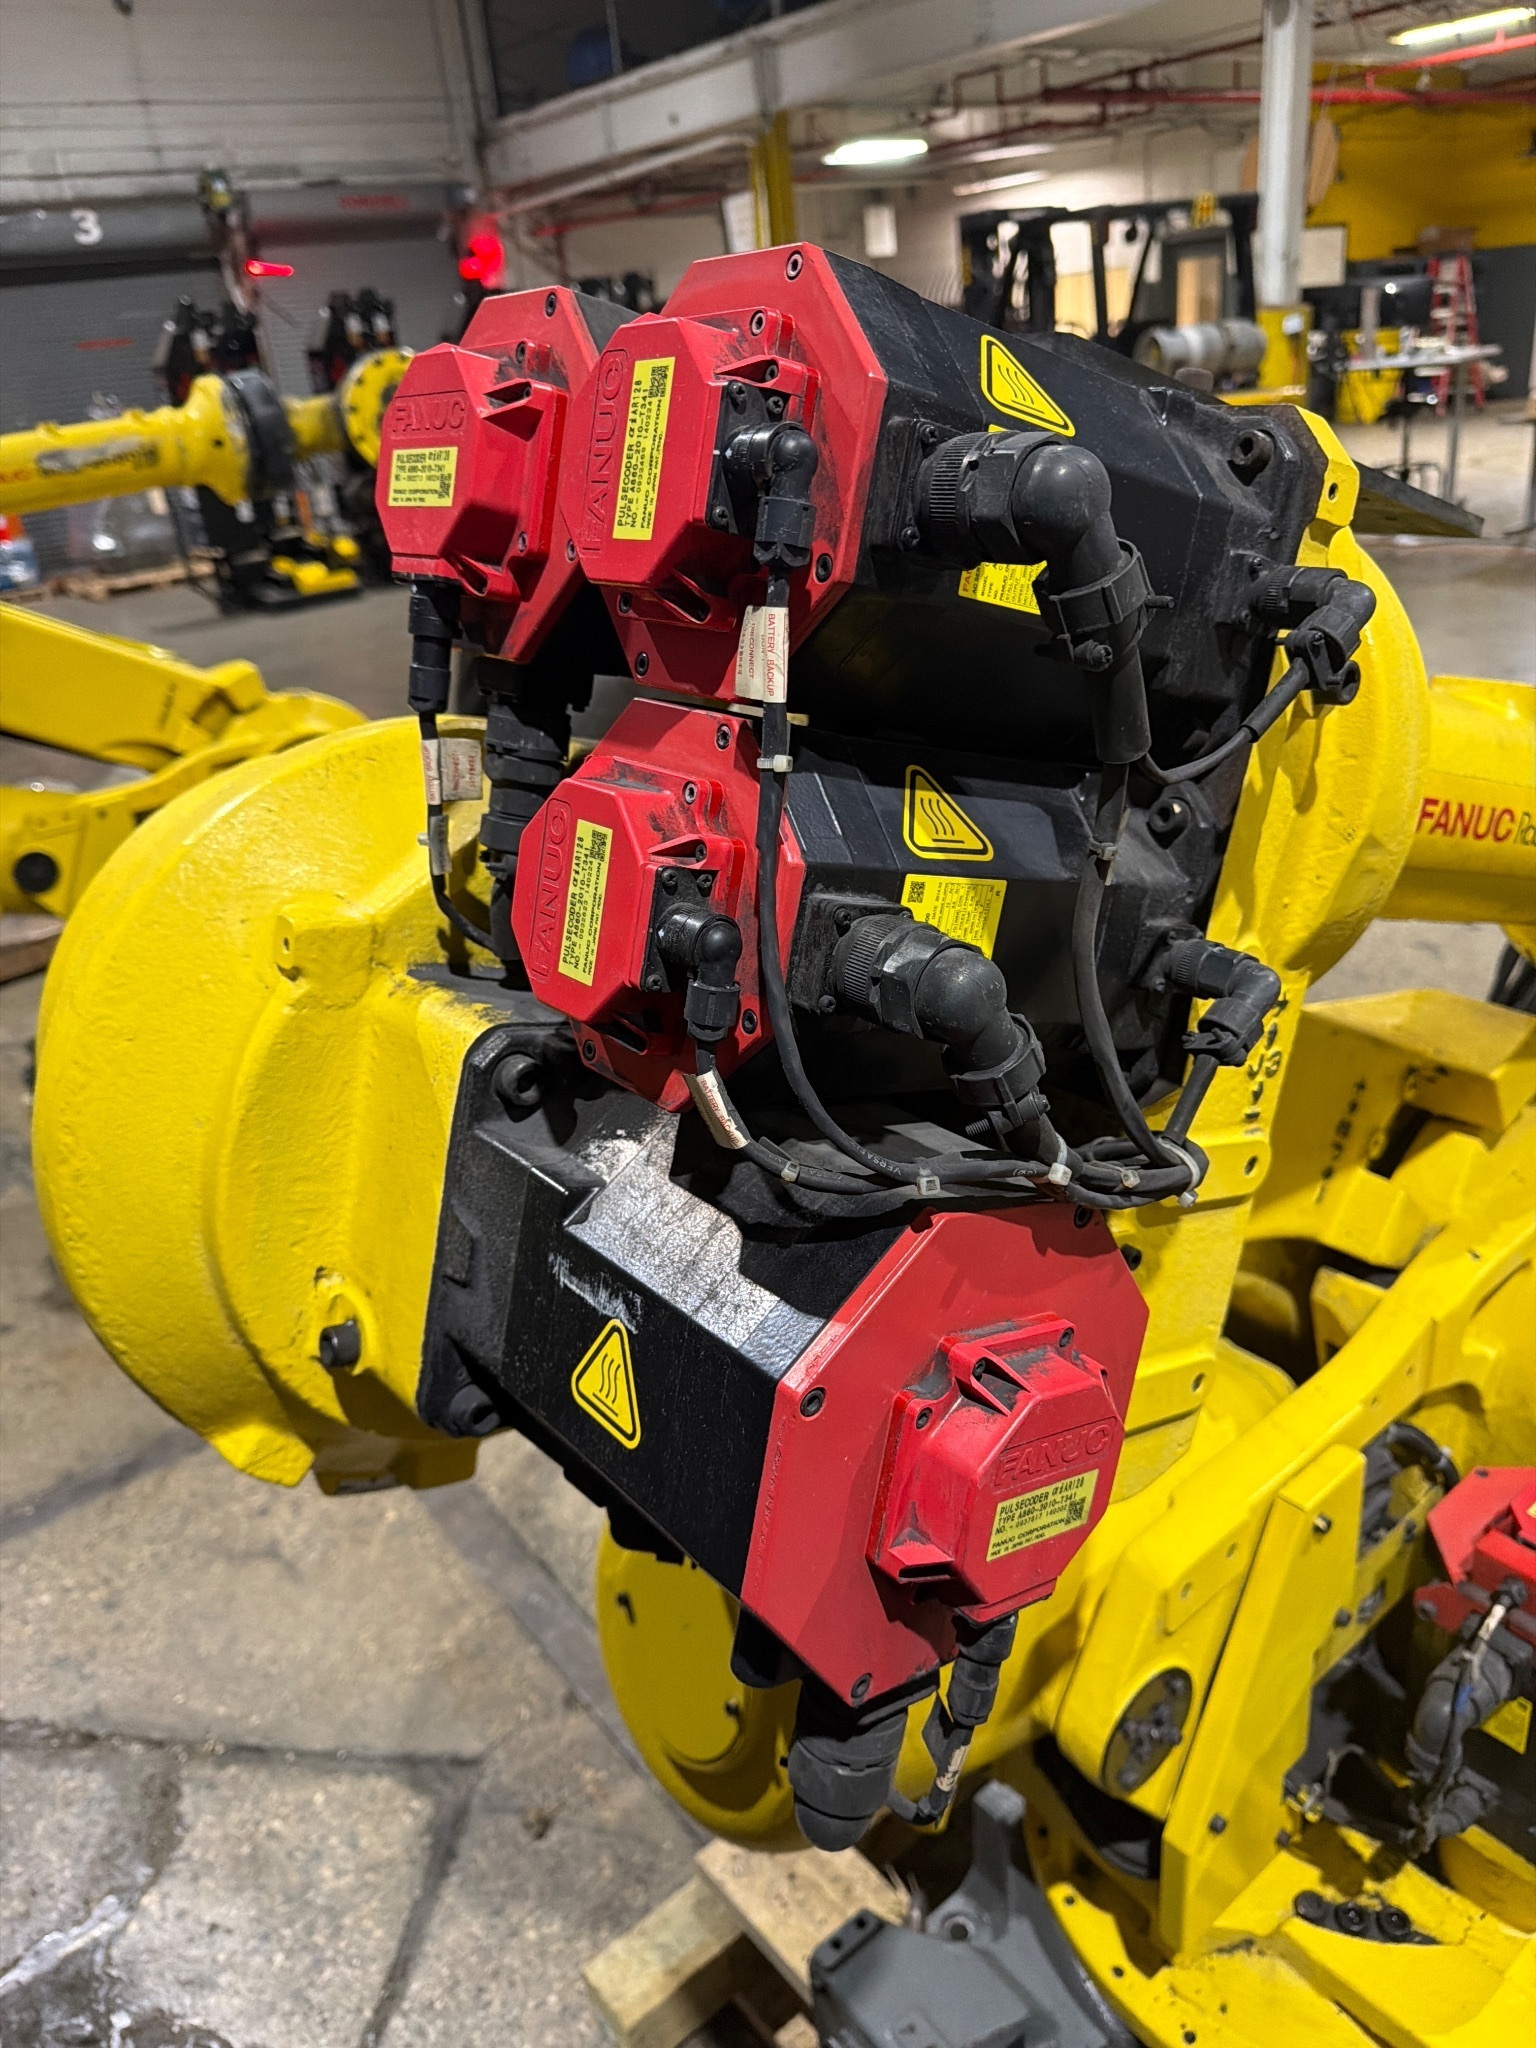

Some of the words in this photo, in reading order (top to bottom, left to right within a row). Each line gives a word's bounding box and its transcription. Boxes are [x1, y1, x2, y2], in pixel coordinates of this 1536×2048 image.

[70, 208, 103, 245] 3
[391, 399, 466, 433] FANUC
[581, 356, 624, 552] FANUC
[640, 490, 649, 528] FANUC
[647, 399, 662, 485] CORPORATION
[617, 444, 634, 526] PULSECODER
[624, 498, 634, 526] TYPE
[767, 613, 776, 655] BATTERY
[766, 659, 775, 697] BACKUP
[1415, 797, 1515, 843] FANUC
[531, 806, 569, 977] FANUC
[562, 892, 577, 964] PULSECODER
[582, 940, 590, 973] FANUC
[588, 862, 601, 936] CORPORATION
[568, 941, 577, 965] TYPE
[701, 1079, 721, 1113] BATTERY
[718, 1114, 740, 1148] BACKUP
[992, 1424, 1110, 1487] FANUC
[998, 1513, 1016, 1526] TYPE
[1000, 1492, 1049, 1516] PULSECODER
